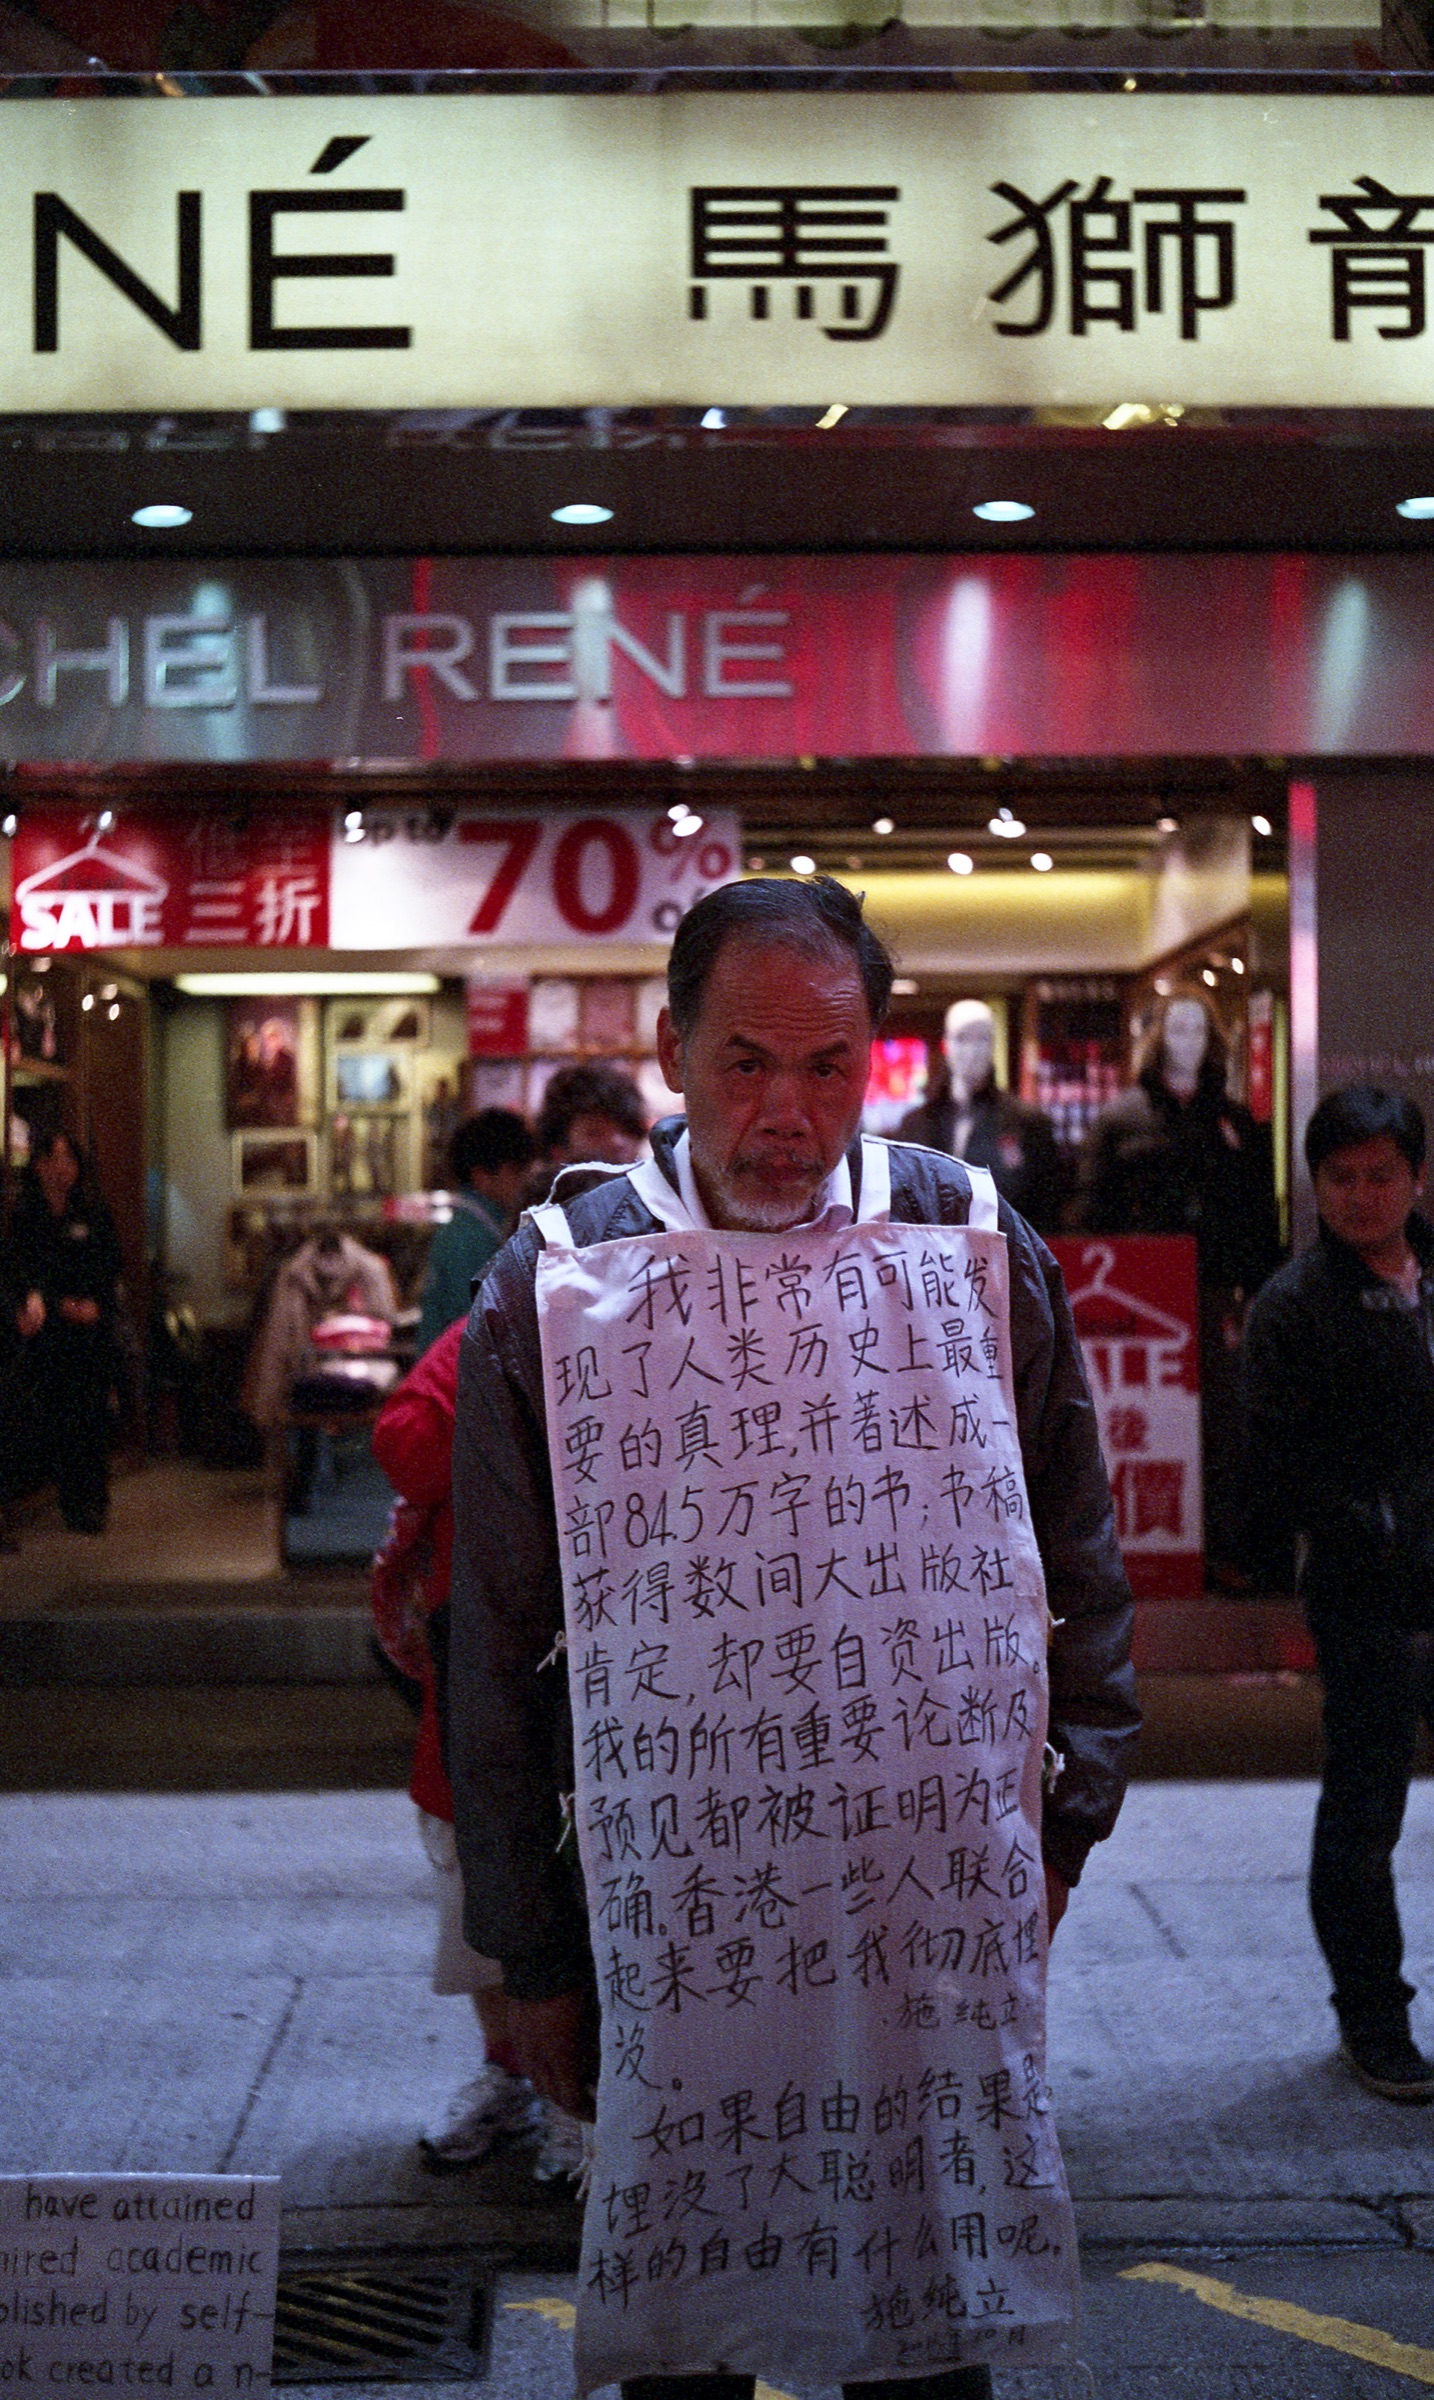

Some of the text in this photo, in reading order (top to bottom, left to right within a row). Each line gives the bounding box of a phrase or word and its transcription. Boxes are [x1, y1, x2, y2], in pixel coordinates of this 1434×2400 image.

[384, 584, 794, 704] RENÉ
[185, 876, 322, 945] 三折
[457, 816, 733, 937] 70%
[20, 894, 165, 950] SALE
[626, 1249, 998, 1329] 我非常有可能发
[554, 1316, 1003, 1407] 现了人类历史上最重
[570, 1541, 1014, 1632] 获得数间大出版社
[582, 1689, 1035, 1781] 我的所有重要论断及
[588, 1768, 1022, 1861] 预见都被证明为正
[25, 2183, 255, 2221] have attained
[107, 2232, 263, 2274] academic
[126, 2290, 158, 2341] by
[50, 2351, 174, 2386] created
